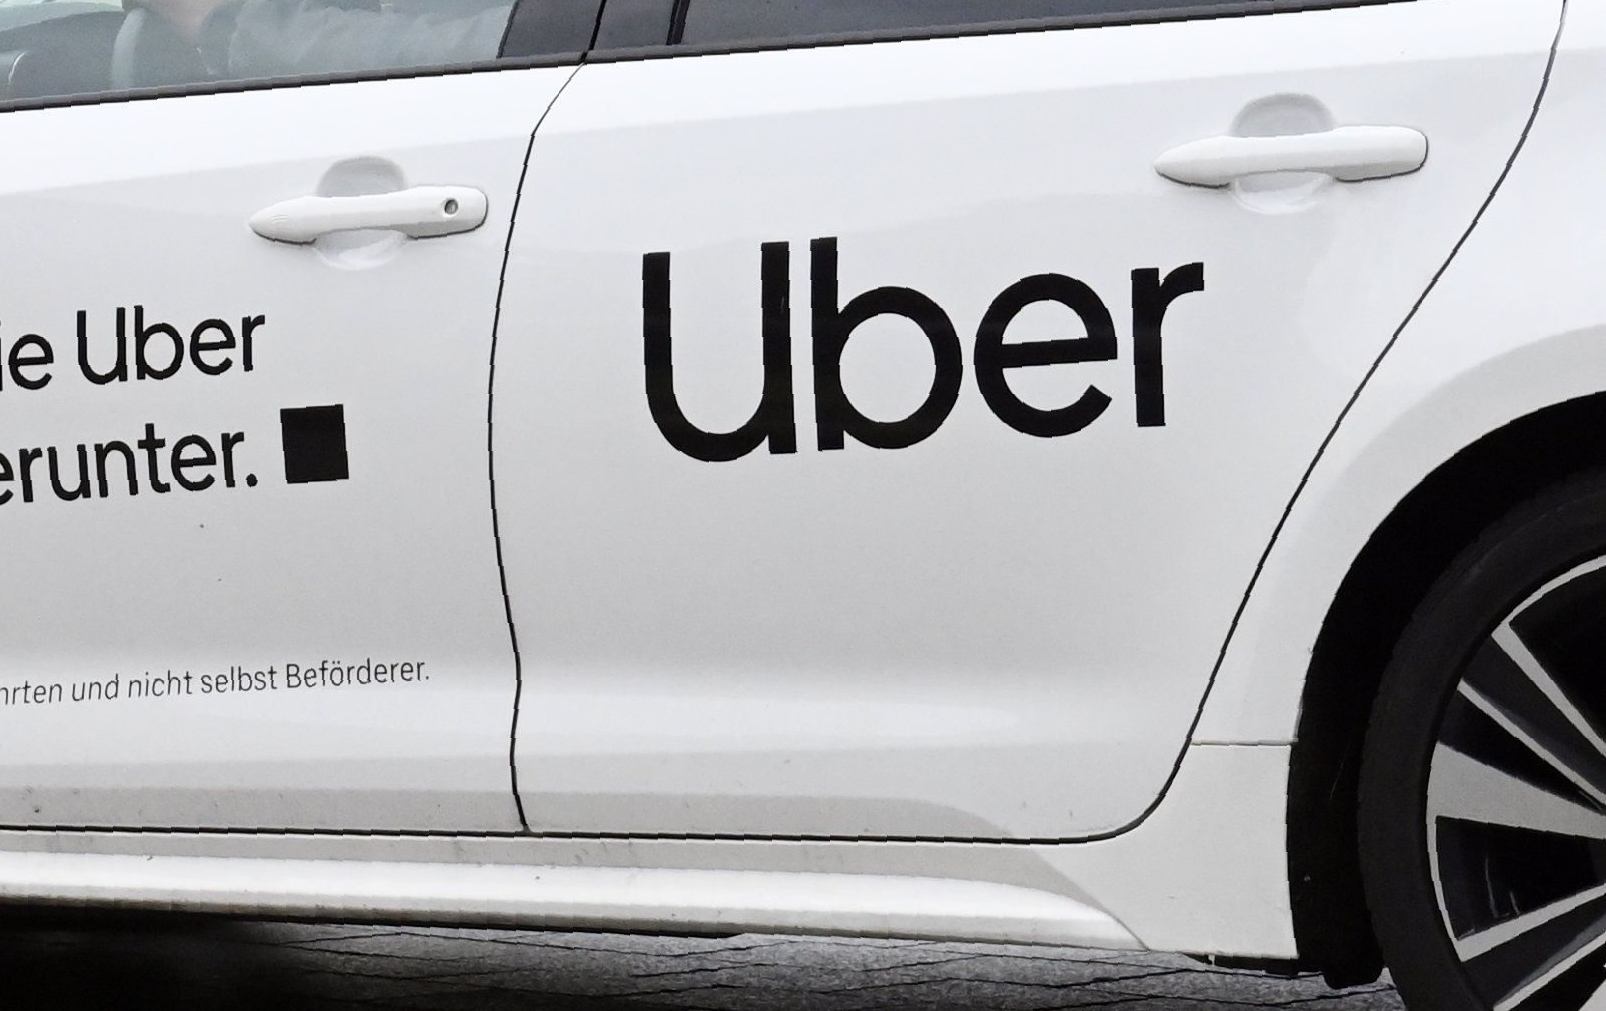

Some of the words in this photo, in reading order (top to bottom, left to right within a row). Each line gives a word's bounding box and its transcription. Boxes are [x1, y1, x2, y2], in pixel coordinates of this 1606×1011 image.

[76, 305, 266, 386] Uber
[641, 236, 1205, 463] Uber
[71, 674, 120, 702] und
[128, 670, 194, 698] nicht
[200, 666, 278, 694] selbst
[286, 657, 430, 688] Beförderer.
